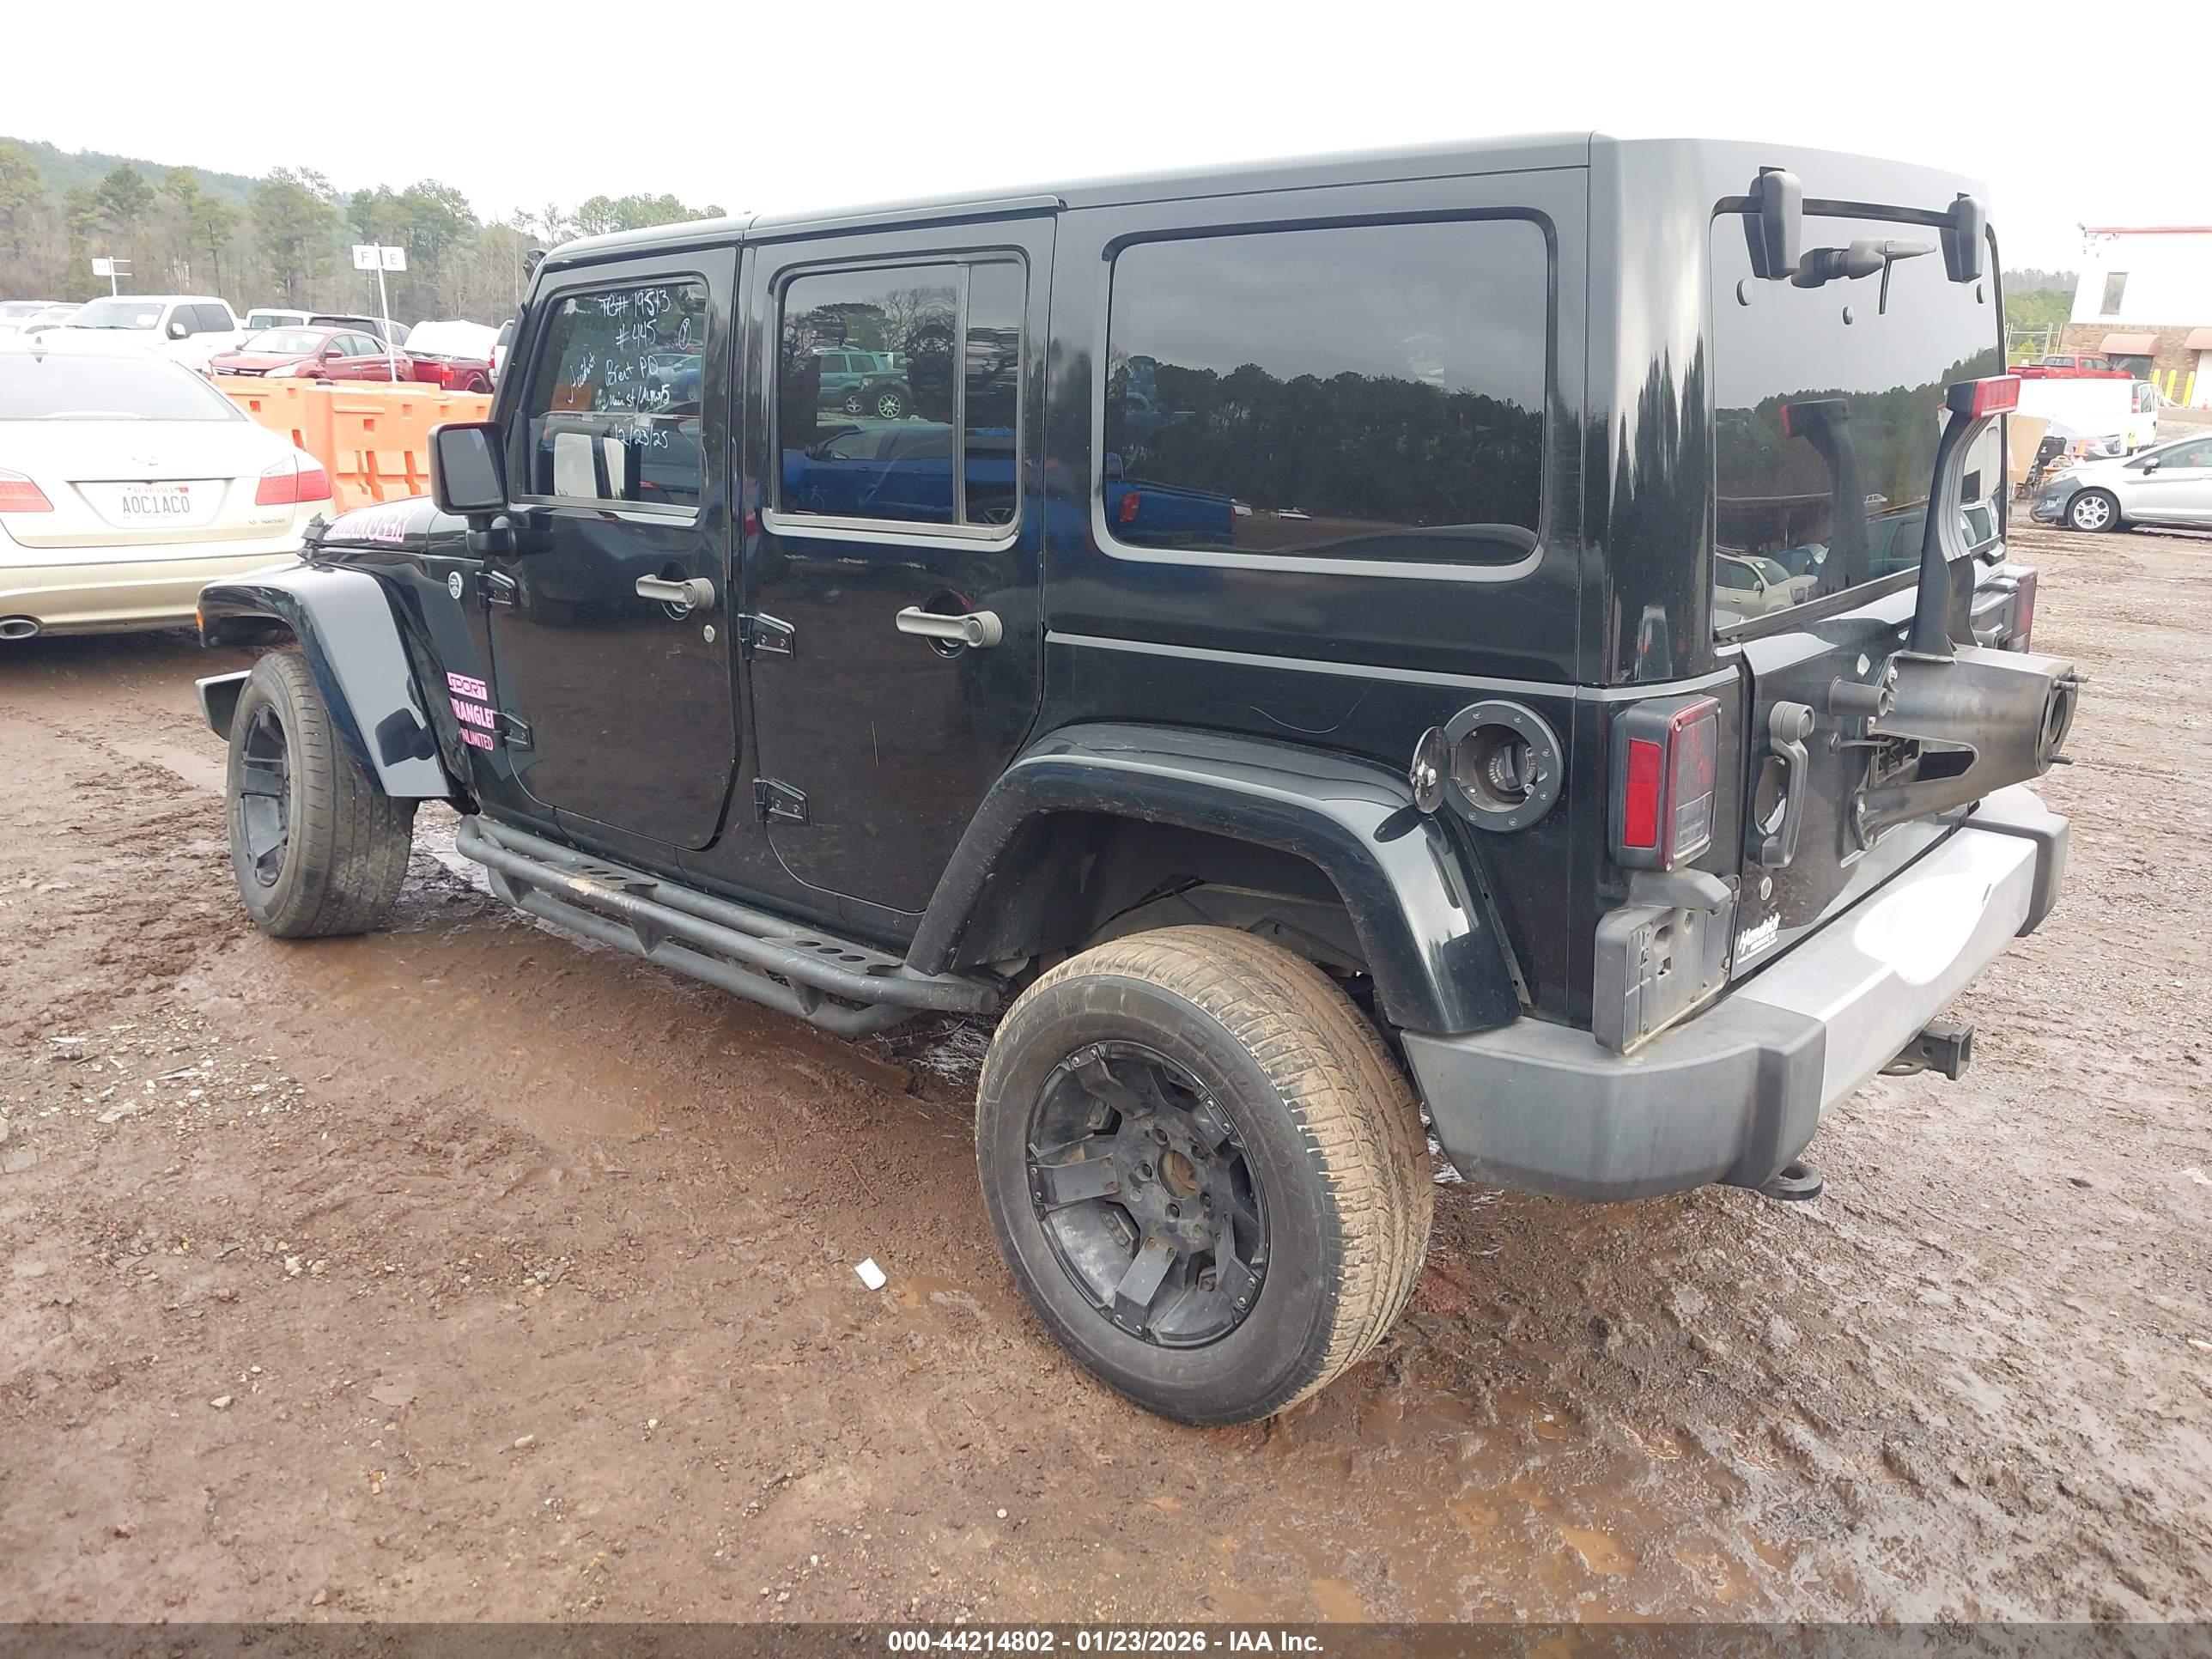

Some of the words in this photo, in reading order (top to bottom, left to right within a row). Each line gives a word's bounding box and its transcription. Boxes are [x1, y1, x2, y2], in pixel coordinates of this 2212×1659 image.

[361, 251, 371, 263] F
[390, 253, 398, 265] E
[632, 289, 671, 318] 19513
[614, 423, 669, 450] 12/23/25
[448, 674, 487, 699] SPORT
[1737, 912, 1781, 955] Hendrick
